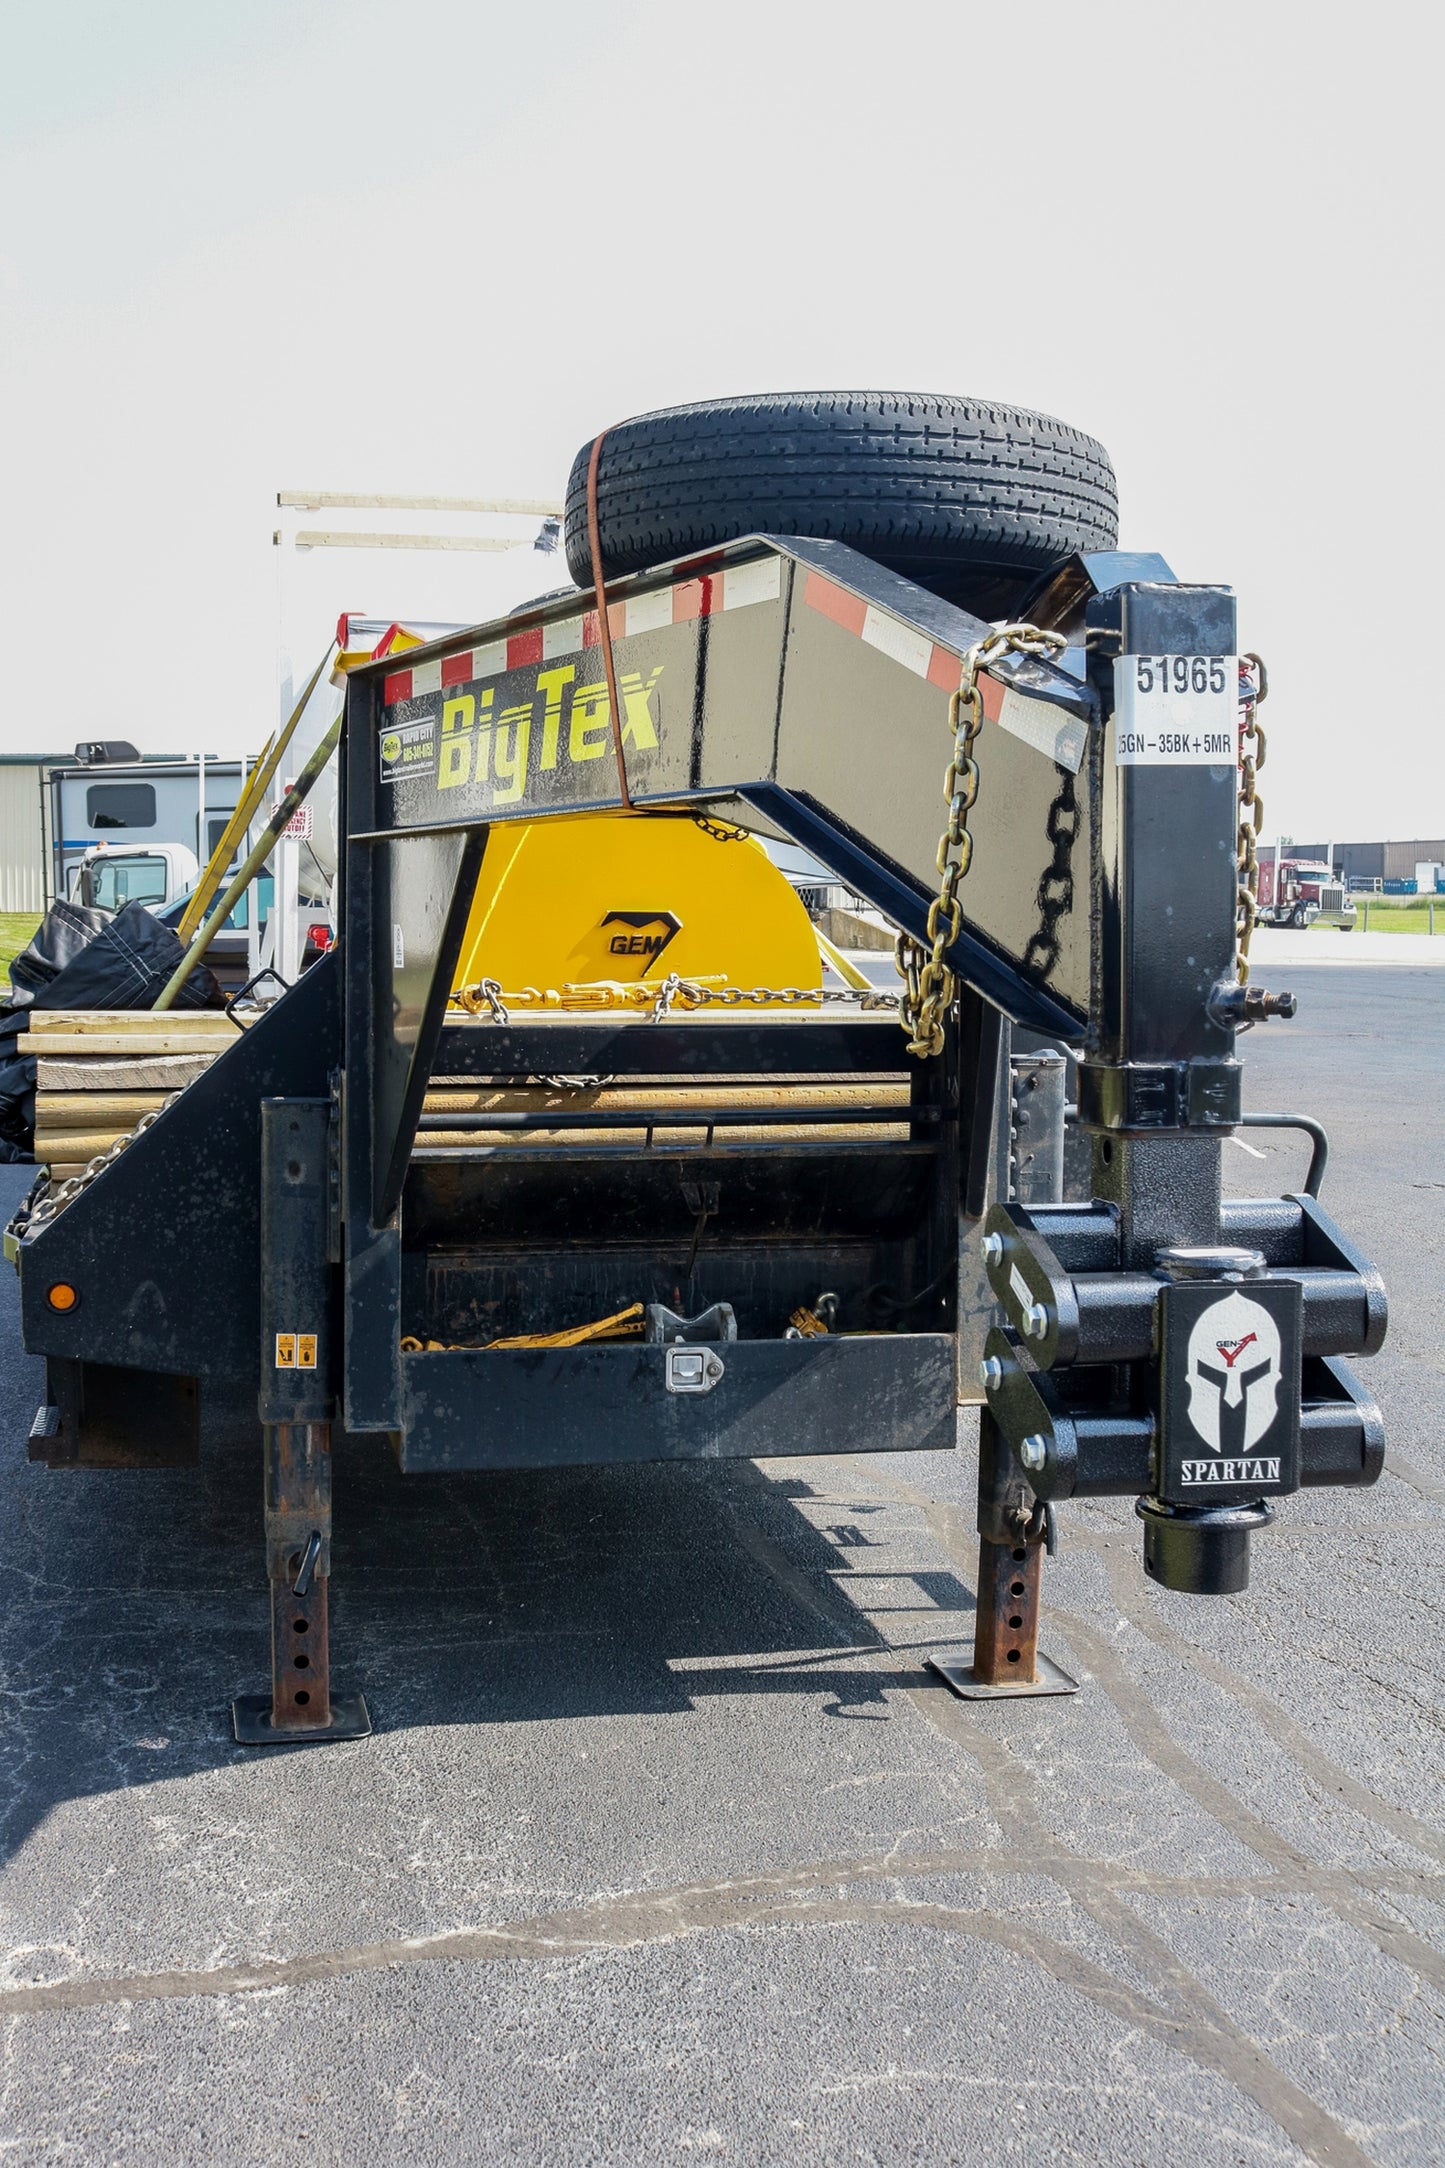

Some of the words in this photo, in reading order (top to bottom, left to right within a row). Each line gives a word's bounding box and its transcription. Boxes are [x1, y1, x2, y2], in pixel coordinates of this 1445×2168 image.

[1137, 657, 1226, 694] 51965
[419, 727, 433, 741] CITY
[609, 936, 662, 955] GEM
[1181, 1461, 1281, 1482] SPARTAN
